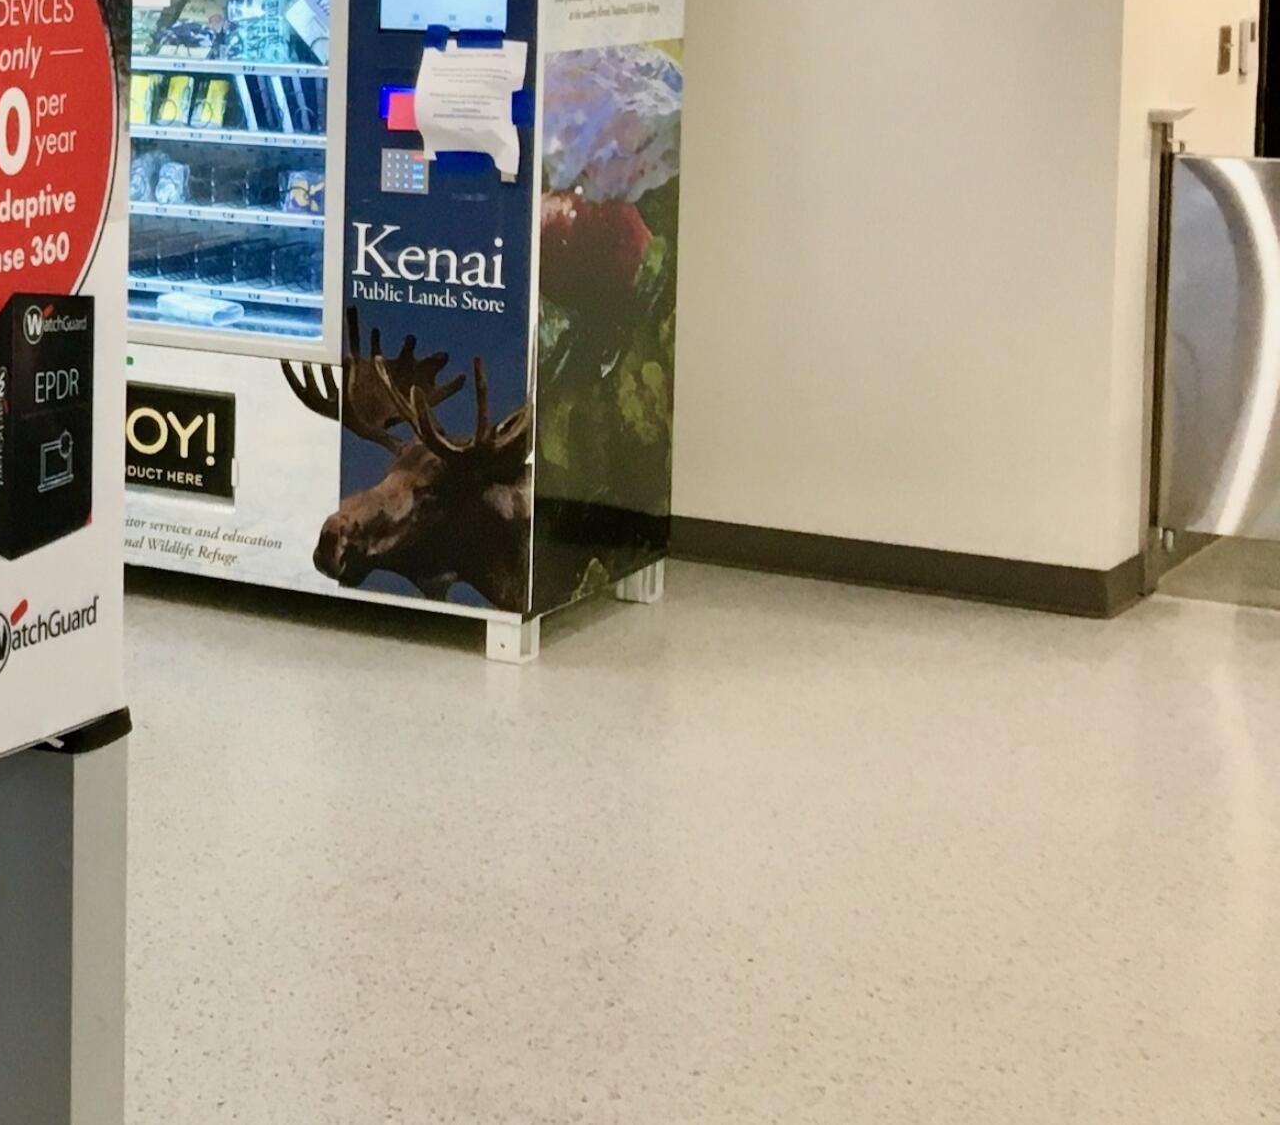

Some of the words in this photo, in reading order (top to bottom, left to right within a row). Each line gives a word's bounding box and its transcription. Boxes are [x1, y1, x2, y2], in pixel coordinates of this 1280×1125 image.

[0, 39, 42, 79] only
[36, 93, 67, 126] per
[35, 131, 76, 166] year
[31, 232, 69, 266] 360
[352, 222, 505, 289] Kenai
[353, 280, 402, 302] Public
[409, 286, 457, 307] Lands
[462, 292, 504, 313] Store
[24, 309, 87, 341] WatchGuard
[35, 368, 79, 403] EPDR
[126, 465, 163, 480] DUCT
[167, 471, 202, 486] HERE
[147, 538, 194, 559] Wildlife
[149, 520, 192, 535] services
[195, 527, 219, 541] and
[222, 529, 283, 549] education
